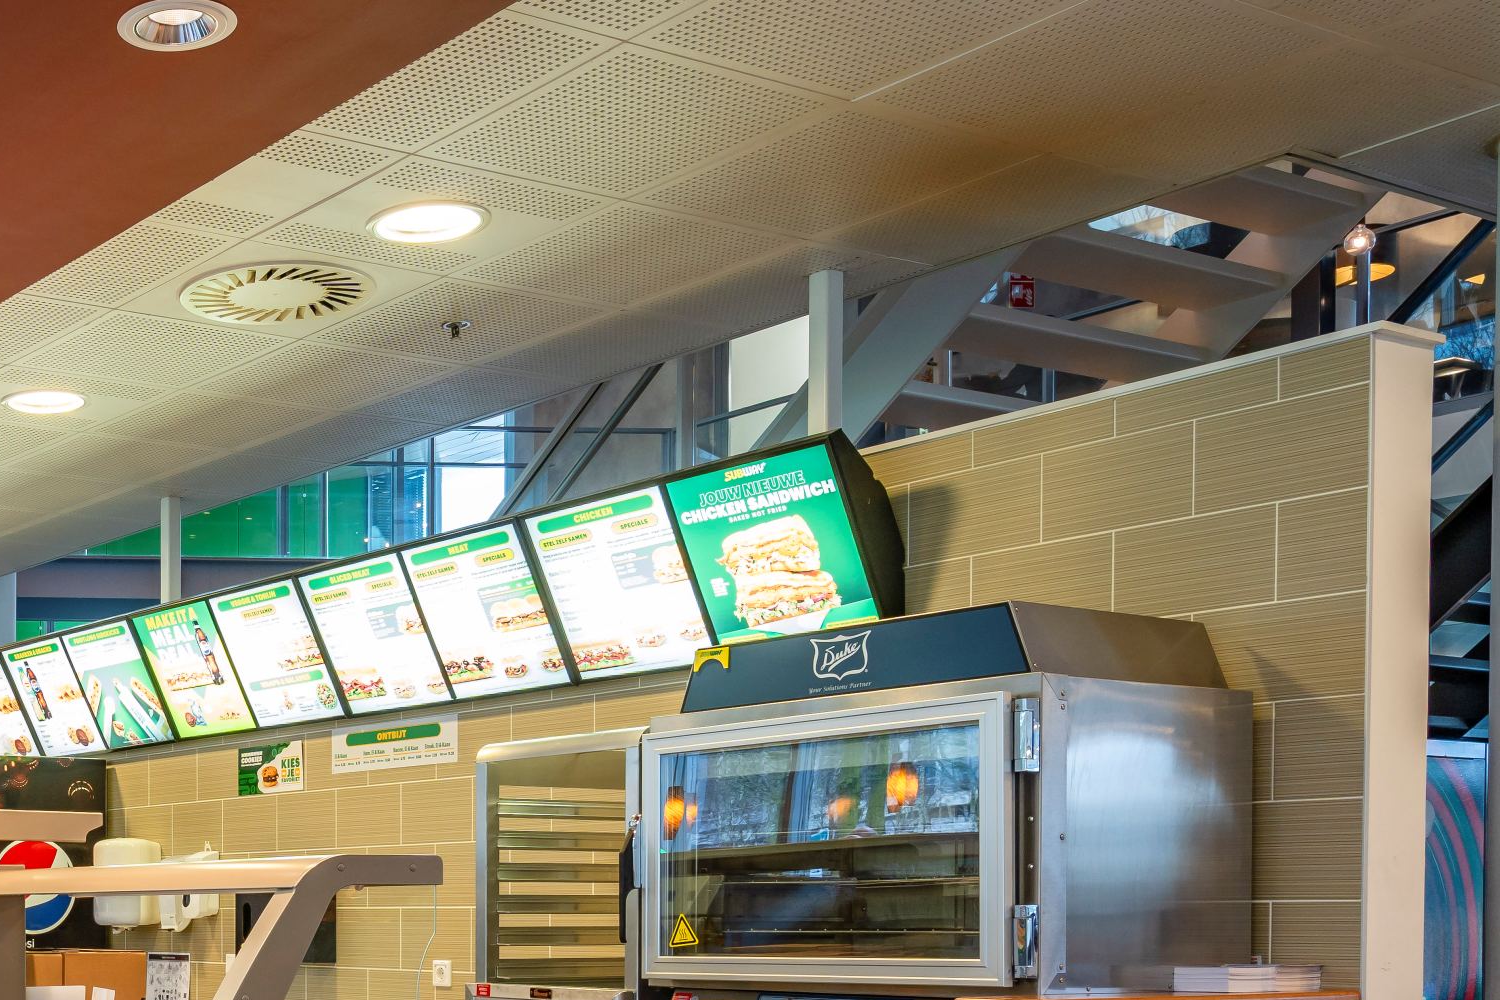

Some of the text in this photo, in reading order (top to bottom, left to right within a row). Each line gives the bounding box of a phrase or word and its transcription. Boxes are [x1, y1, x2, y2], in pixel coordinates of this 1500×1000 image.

[724, 462, 766, 482] SUBWAY
[699, 471, 806, 507] JOUW NIEUWE
[681, 478, 836, 525] CHICKEN SANDWICH
[574, 506, 613, 523] CHICKEN
[728, 505, 788, 523] BAKED NOT FRIED
[620, 518, 649, 530] SPECIALS
[567, 532, 588, 543] SAMEN
[448, 544, 469, 554] MEAT
[482, 552, 507, 563] SPECIALS
[145, 607, 197, 631] MAKE IT A
[150, 624, 194, 648] MEAL
[821, 641, 861, 670] Duke
[849, 681, 872, 689] Partner
[376, 730, 407, 741] ONTBIJT
[281, 757, 300, 769] KIES
[287, 768, 295, 777] JE
